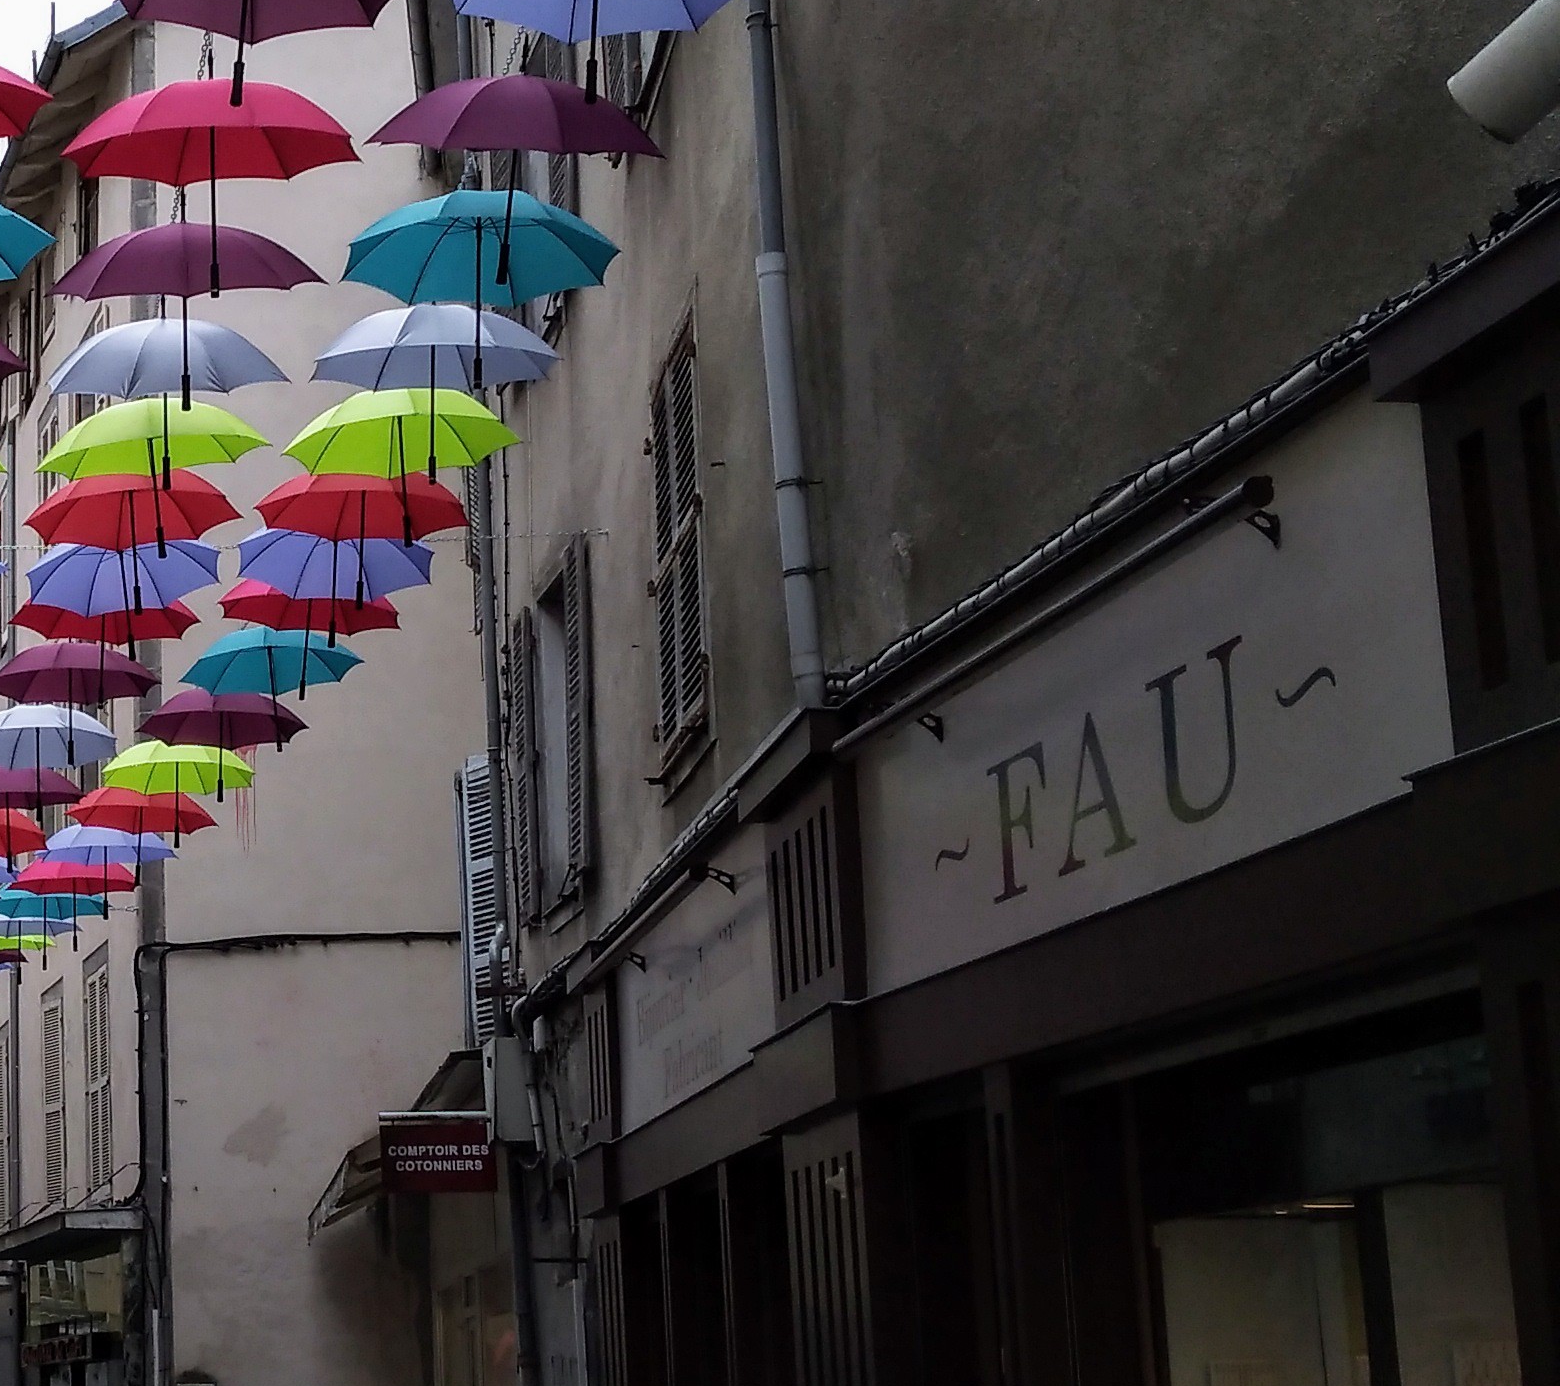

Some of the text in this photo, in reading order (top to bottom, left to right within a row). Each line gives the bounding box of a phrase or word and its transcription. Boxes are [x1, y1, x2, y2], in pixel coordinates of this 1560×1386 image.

[387, 1144, 490, 1157] COMPTOIR DES
[395, 1159, 484, 1172] COTONNIERS
